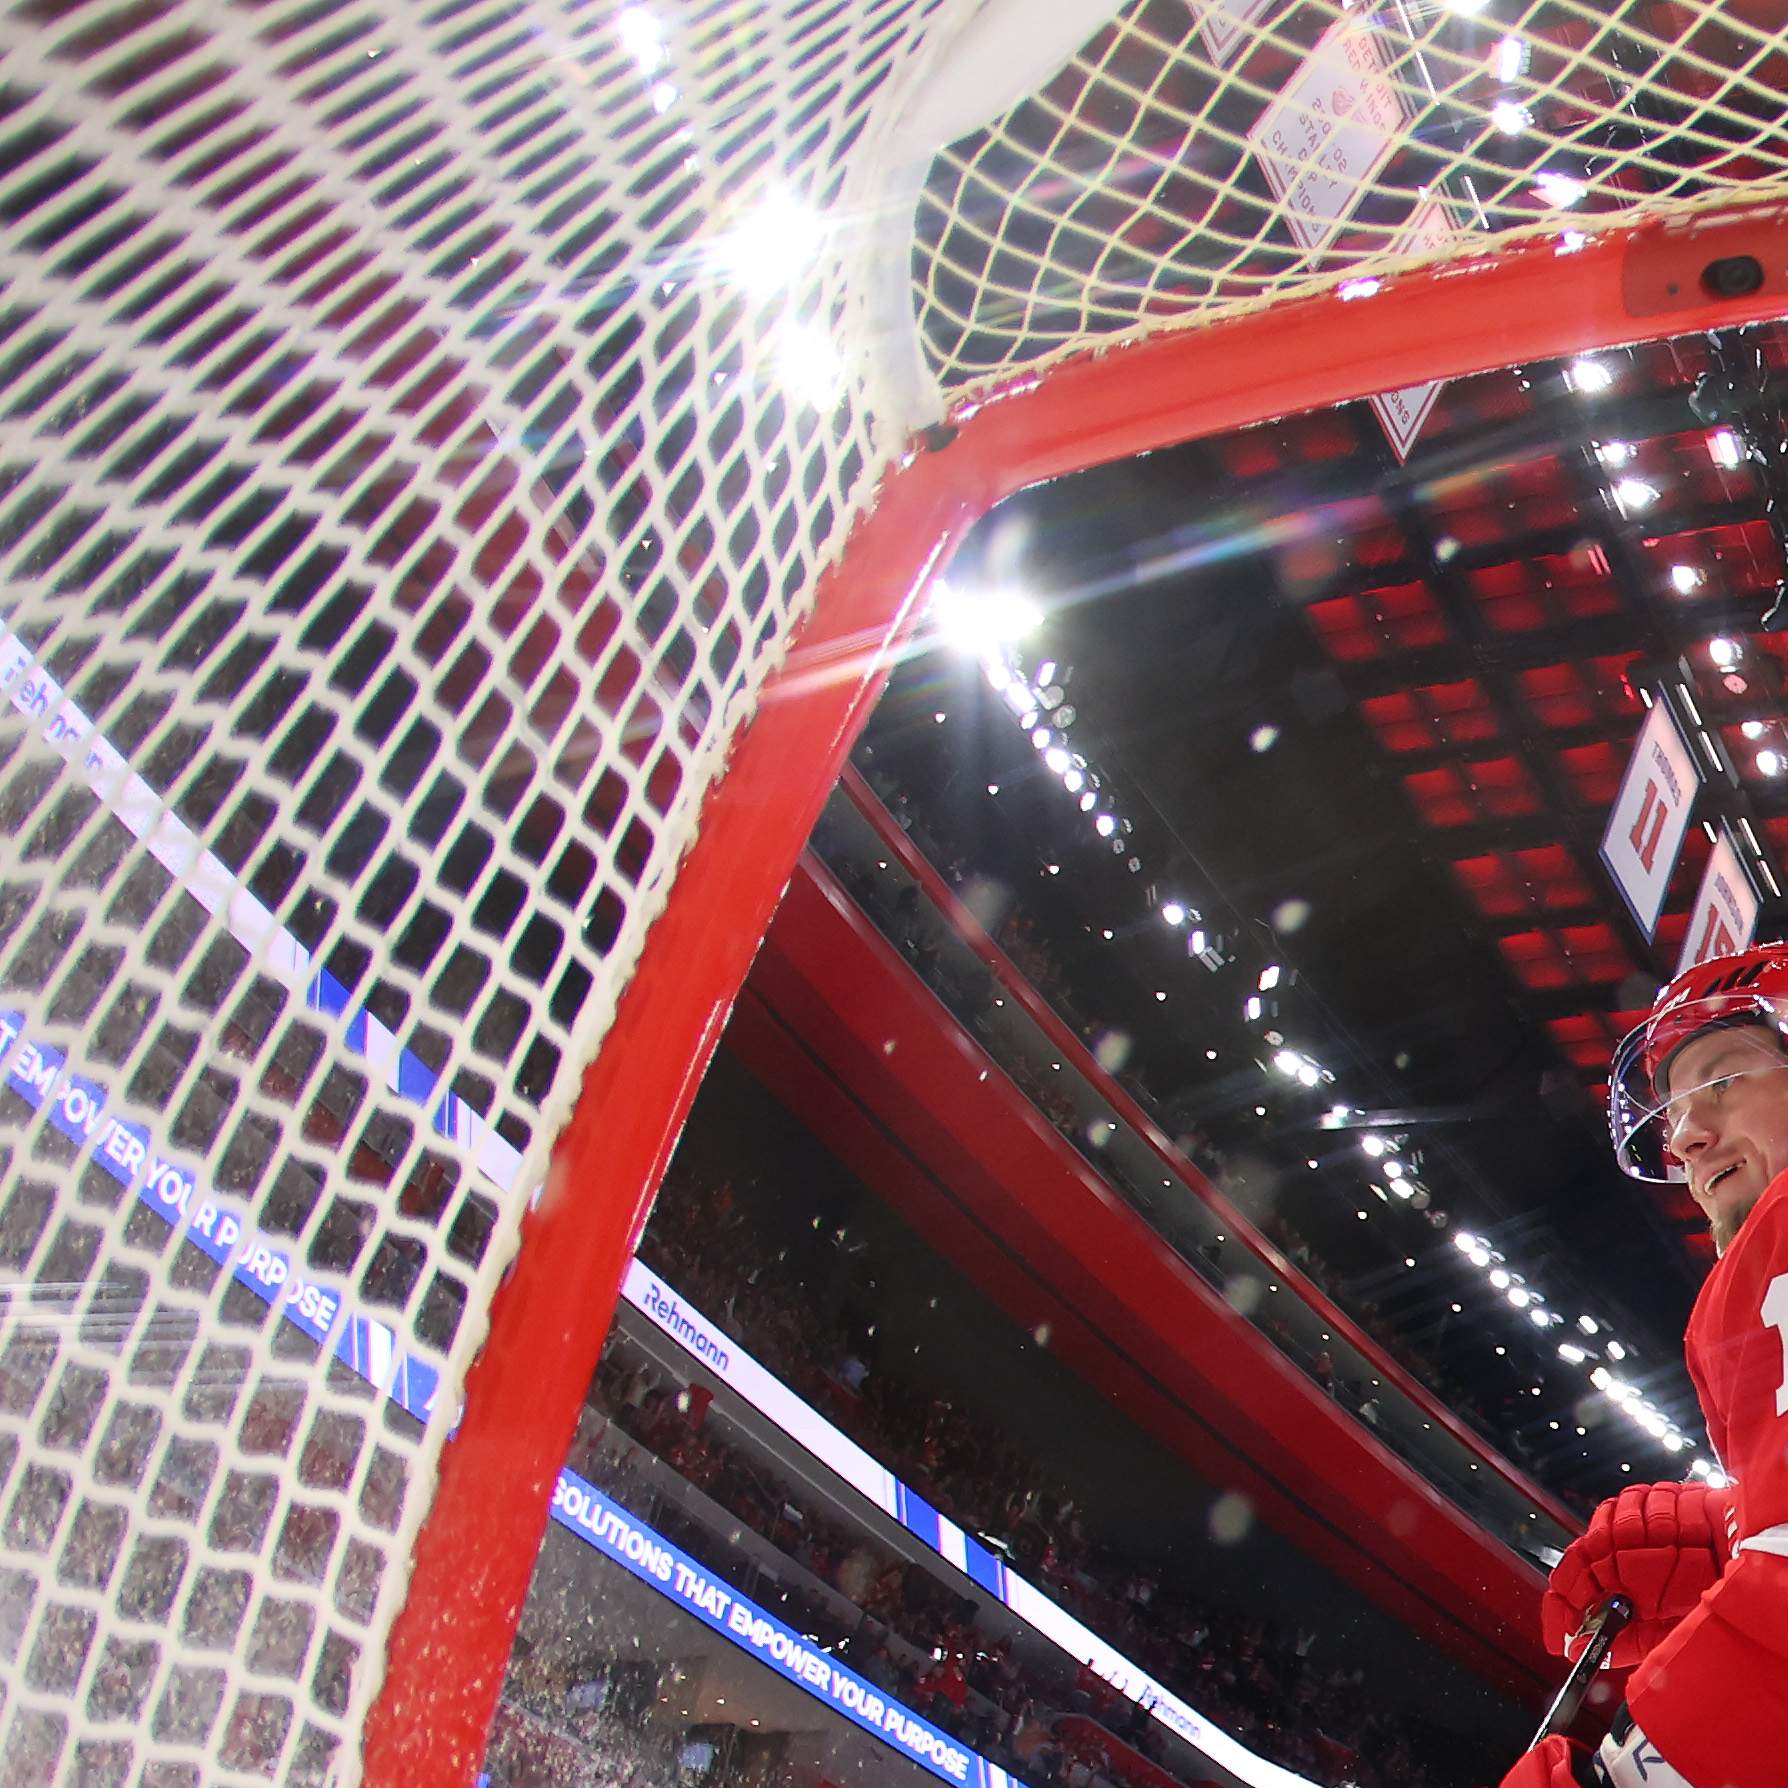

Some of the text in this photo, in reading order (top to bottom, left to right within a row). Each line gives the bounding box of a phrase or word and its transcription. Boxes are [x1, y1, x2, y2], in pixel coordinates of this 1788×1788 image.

[644, 1283, 730, 1371] Rehmann
[553, 1477, 970, 1780] SOLUTIONS THAT EMPOWER YOUR PURPOSE
